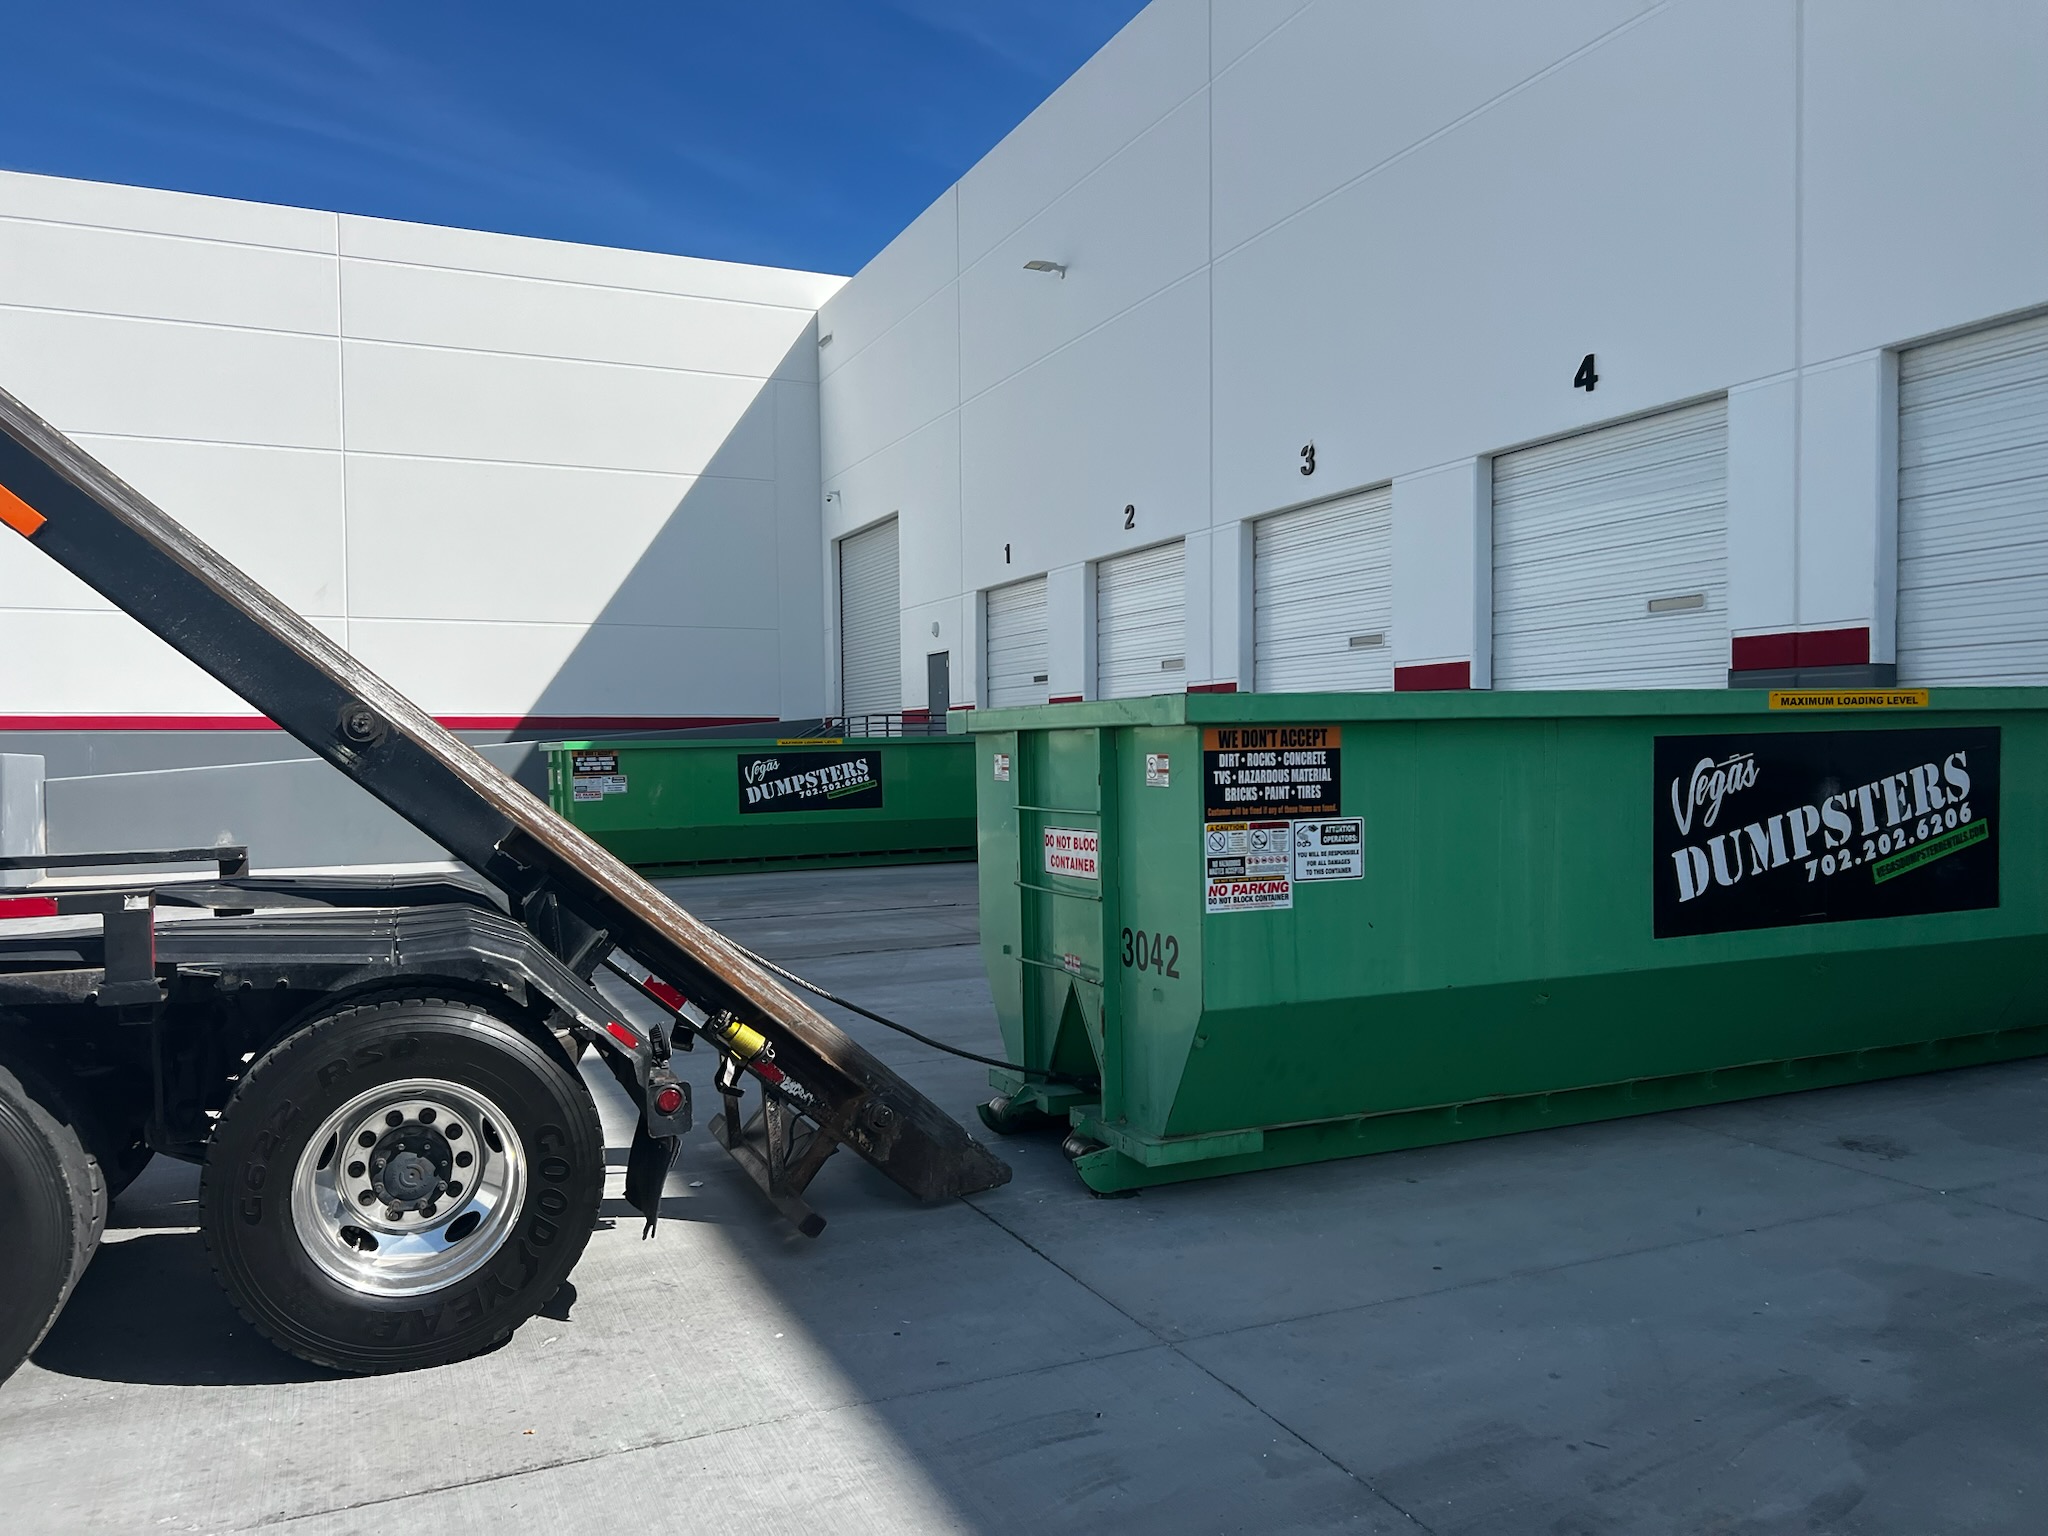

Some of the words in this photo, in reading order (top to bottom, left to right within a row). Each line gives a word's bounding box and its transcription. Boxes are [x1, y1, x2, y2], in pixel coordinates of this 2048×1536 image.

[1574, 354, 1599, 392] 4
[1300, 443, 1315, 475] 3
[1124, 505, 1135, 529] 2
[1004, 544, 1010, 564] 1
[1781, 697, 1833, 706] MAXIMUM
[1838, 696, 1884, 705] LOADING
[1887, 696, 1918, 705] LEVEL
[1218, 730, 1238, 748] WE
[1241, 729, 1278, 748] DON'T
[1280, 728, 1328, 747] ACCEPT
[1219, 753, 1240, 767] DIRT
[1247, 752, 1276, 766] ROCKS
[1283, 751, 1326, 766] CONCRETE
[745, 759, 780, 784] Vegas
[746, 758, 869, 804] DUMPSTERS
[1213, 770, 1231, 784] TVS
[1238, 769, 1289, 784] HAZARDOUS
[1291, 768, 1332, 782] MATERIAL
[799, 775, 870, 799] 702.202.6206
[1225, 787, 1257, 801] BRICKS
[1264, 786, 1290, 800] PAINT
[1296, 785, 1321, 799] TIRES
[1671, 755, 1760, 836] Vegas
[1325, 825, 1356, 833] ATTENTION
[1672, 750, 1971, 902] DUMPSTERS
[1045, 834, 1054, 847] DO
[1056, 835, 1071, 848] NOT
[1805, 801, 1972, 882] 702.202.6206
[1051, 854, 1095, 872] CONTAINER
[1208, 885, 1227, 897] NO
[1231, 881, 1289, 895] PARKING
[1208, 897, 1217, 905] DO
[1219, 896, 1231, 904] NOT
[1233, 895, 1254, 903] BLOCK
[1255, 894, 1289, 902] CONTAINER
[1122, 927, 1179, 979] 3042
[370, 1124, 572, 1344] GOODYEAR
